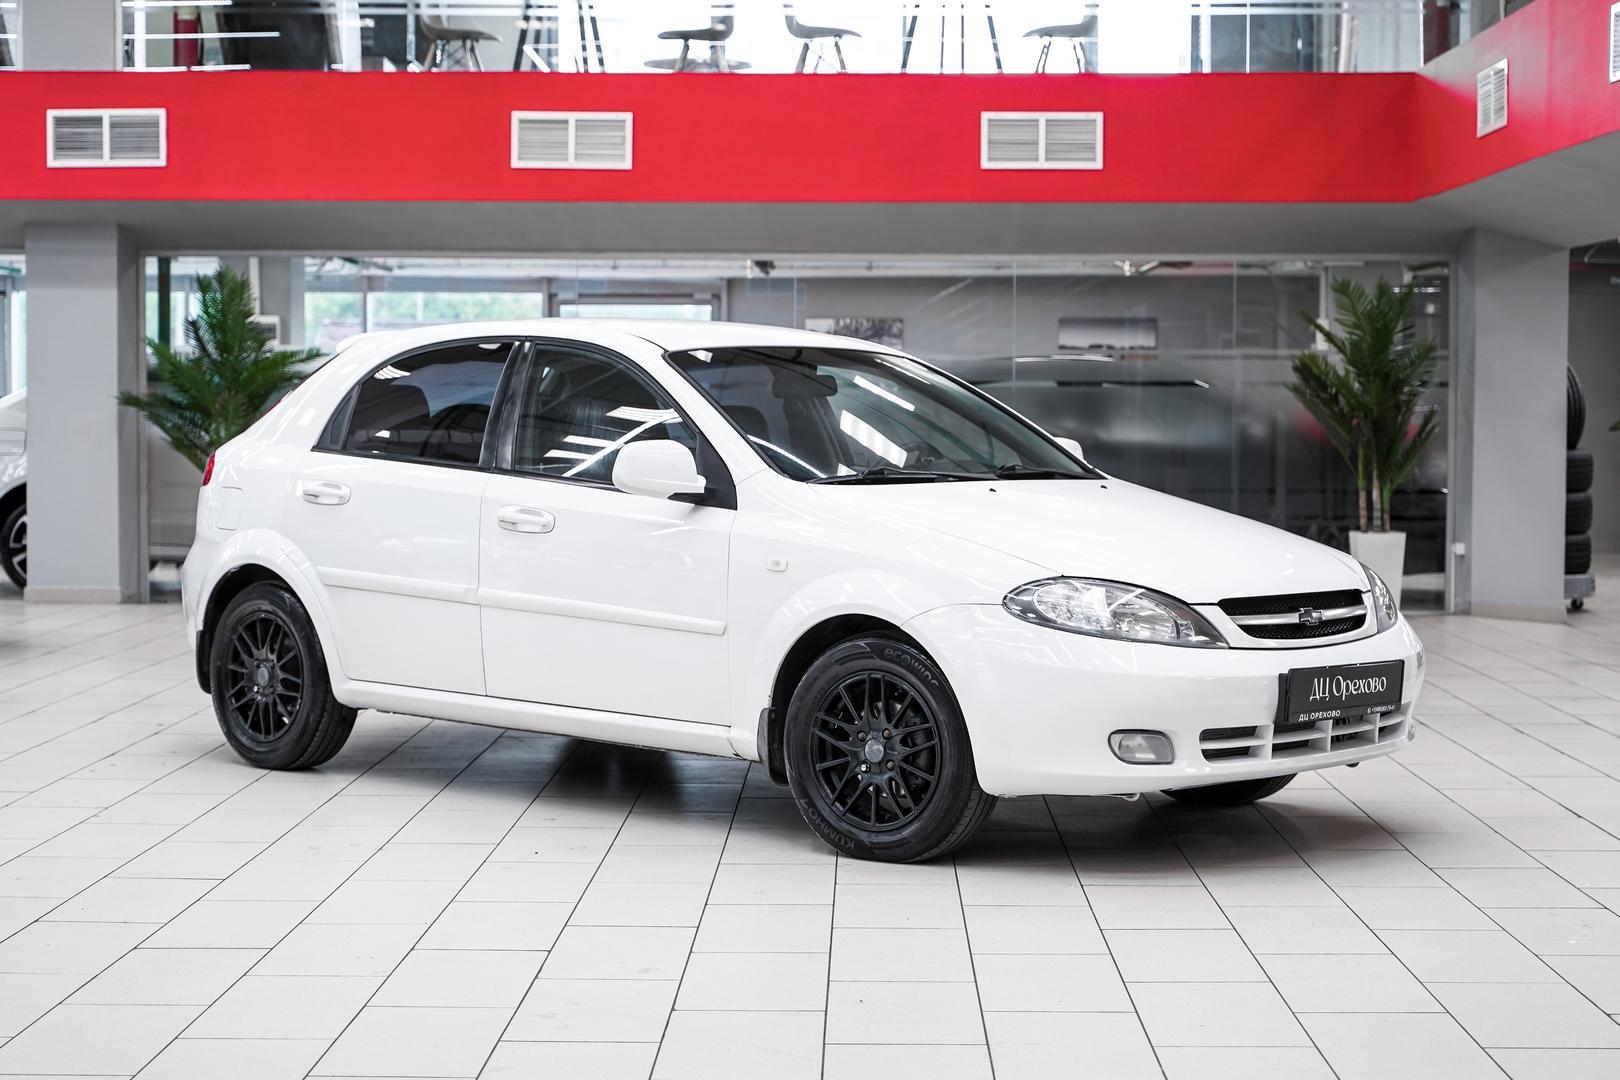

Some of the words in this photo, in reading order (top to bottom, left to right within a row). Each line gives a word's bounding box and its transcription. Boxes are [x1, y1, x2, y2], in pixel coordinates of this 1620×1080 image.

[1309, 677, 1330, 702] ДЦ
[1332, 675, 1387, 701] Орехово
[1298, 713, 1309, 722] ДЦ
[1310, 709, 1341, 720] ОРЕХОВО
[806, 805, 855, 850] KUMHO
